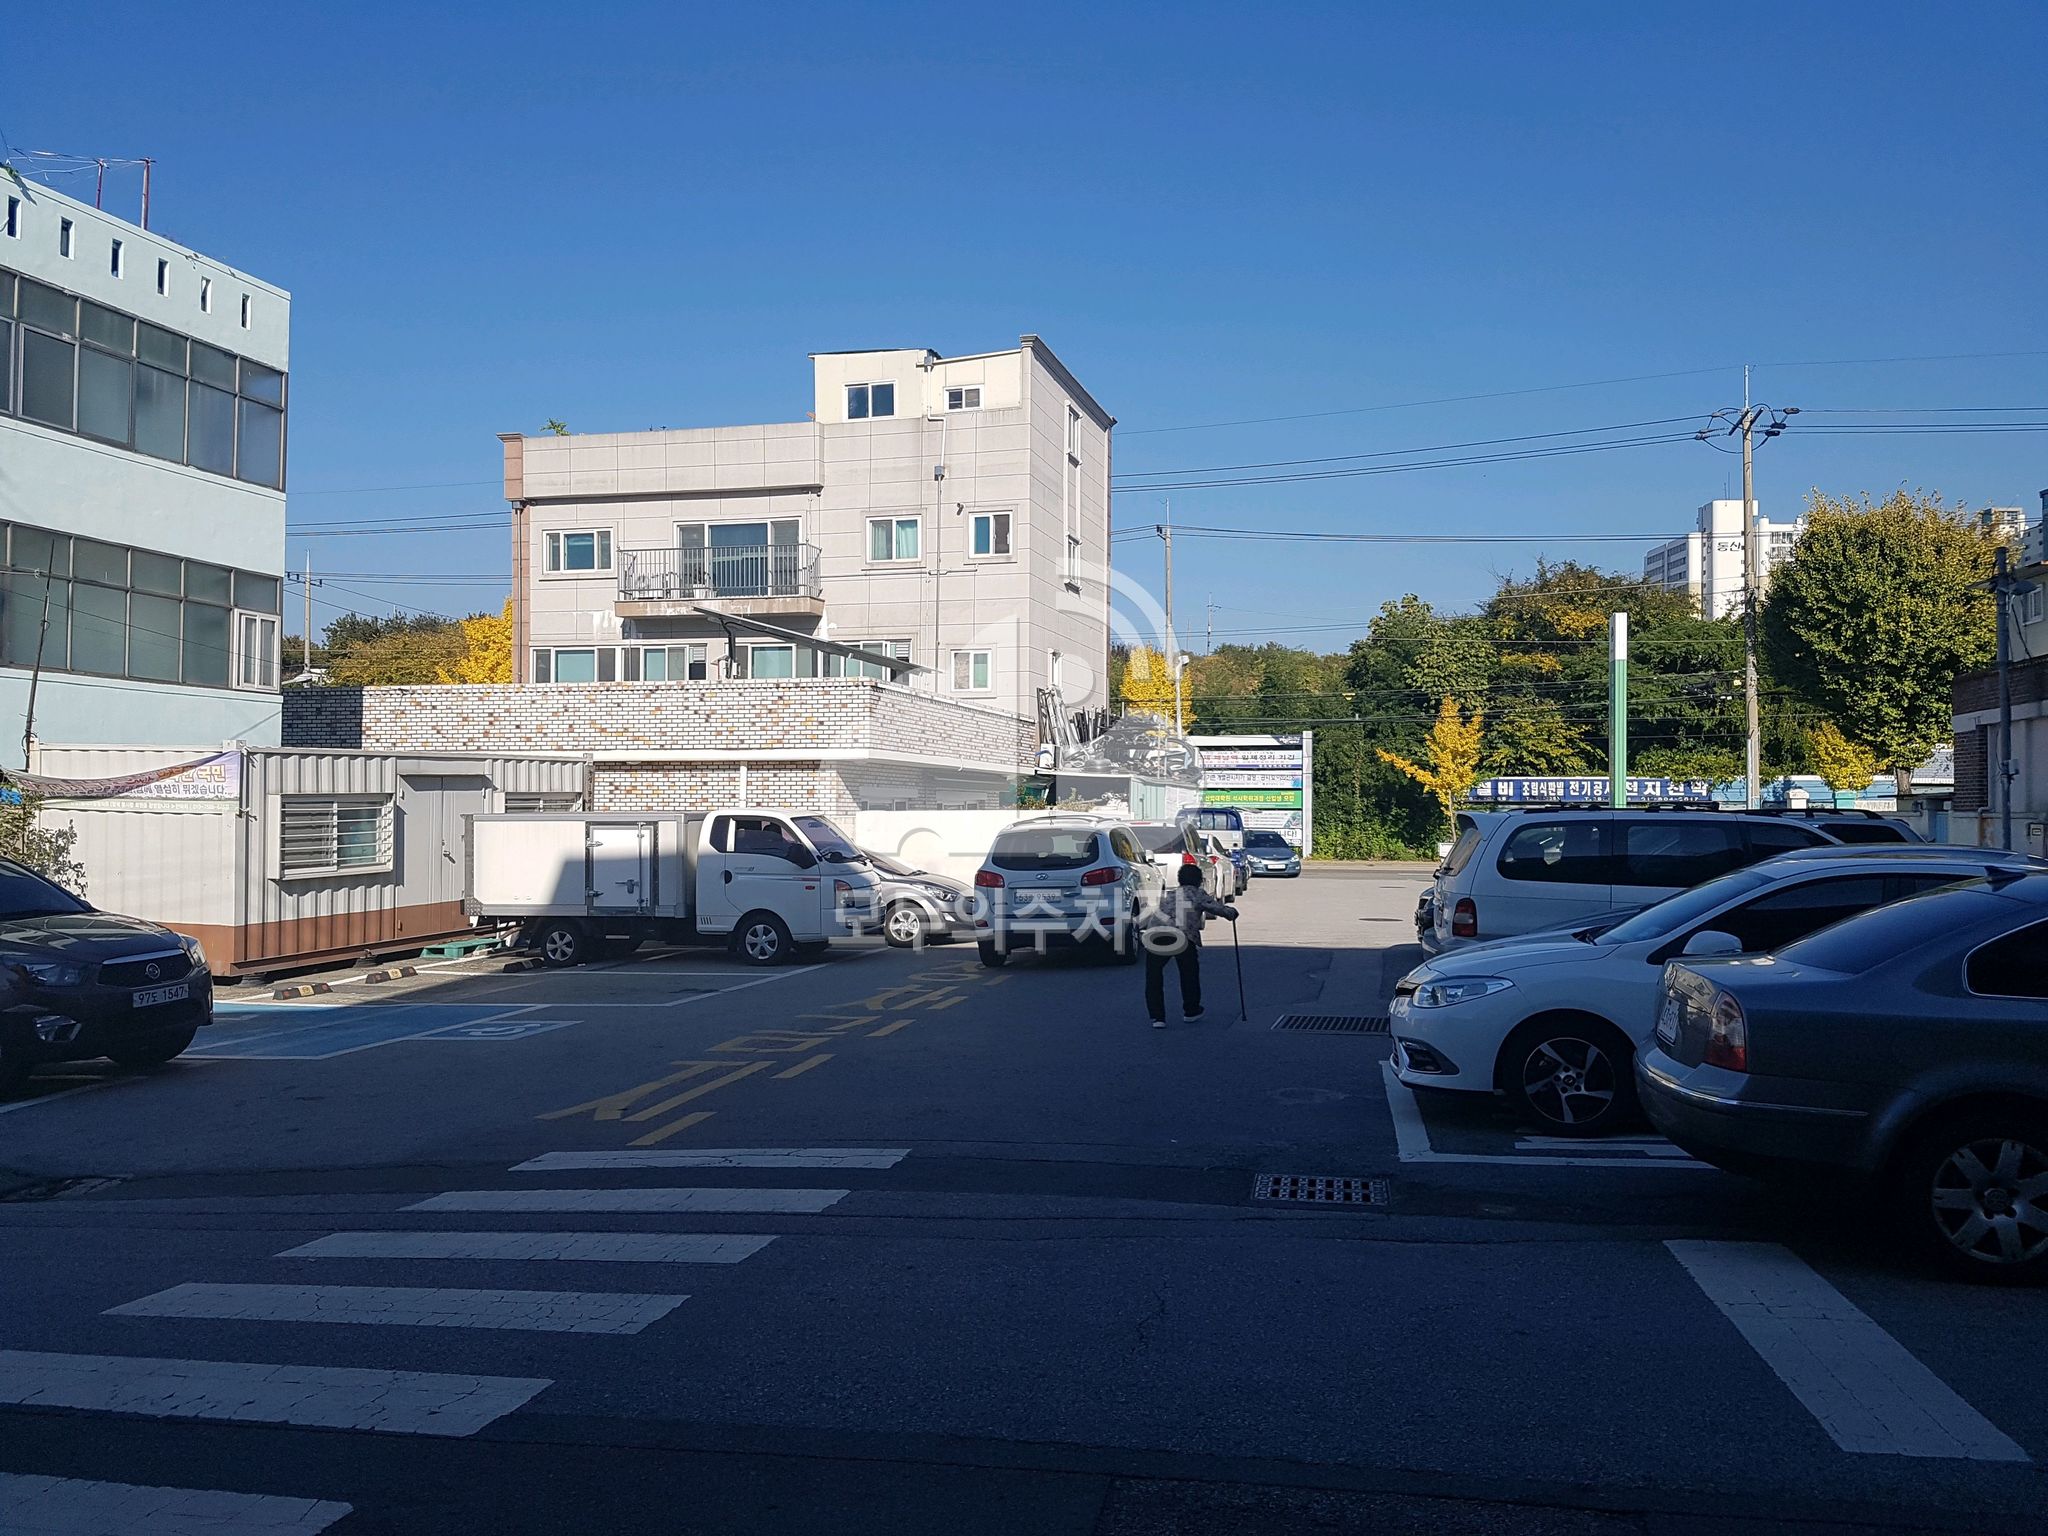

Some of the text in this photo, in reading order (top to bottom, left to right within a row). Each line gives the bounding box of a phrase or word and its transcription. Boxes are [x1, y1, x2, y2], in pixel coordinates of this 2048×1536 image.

[1717, 541, 1741, 552] 동산
[154, 784, 180, 795] 열심히
[1522, 781, 1564, 796] 조립식판넬
[138, 986, 185, 1005] 97도 1547
